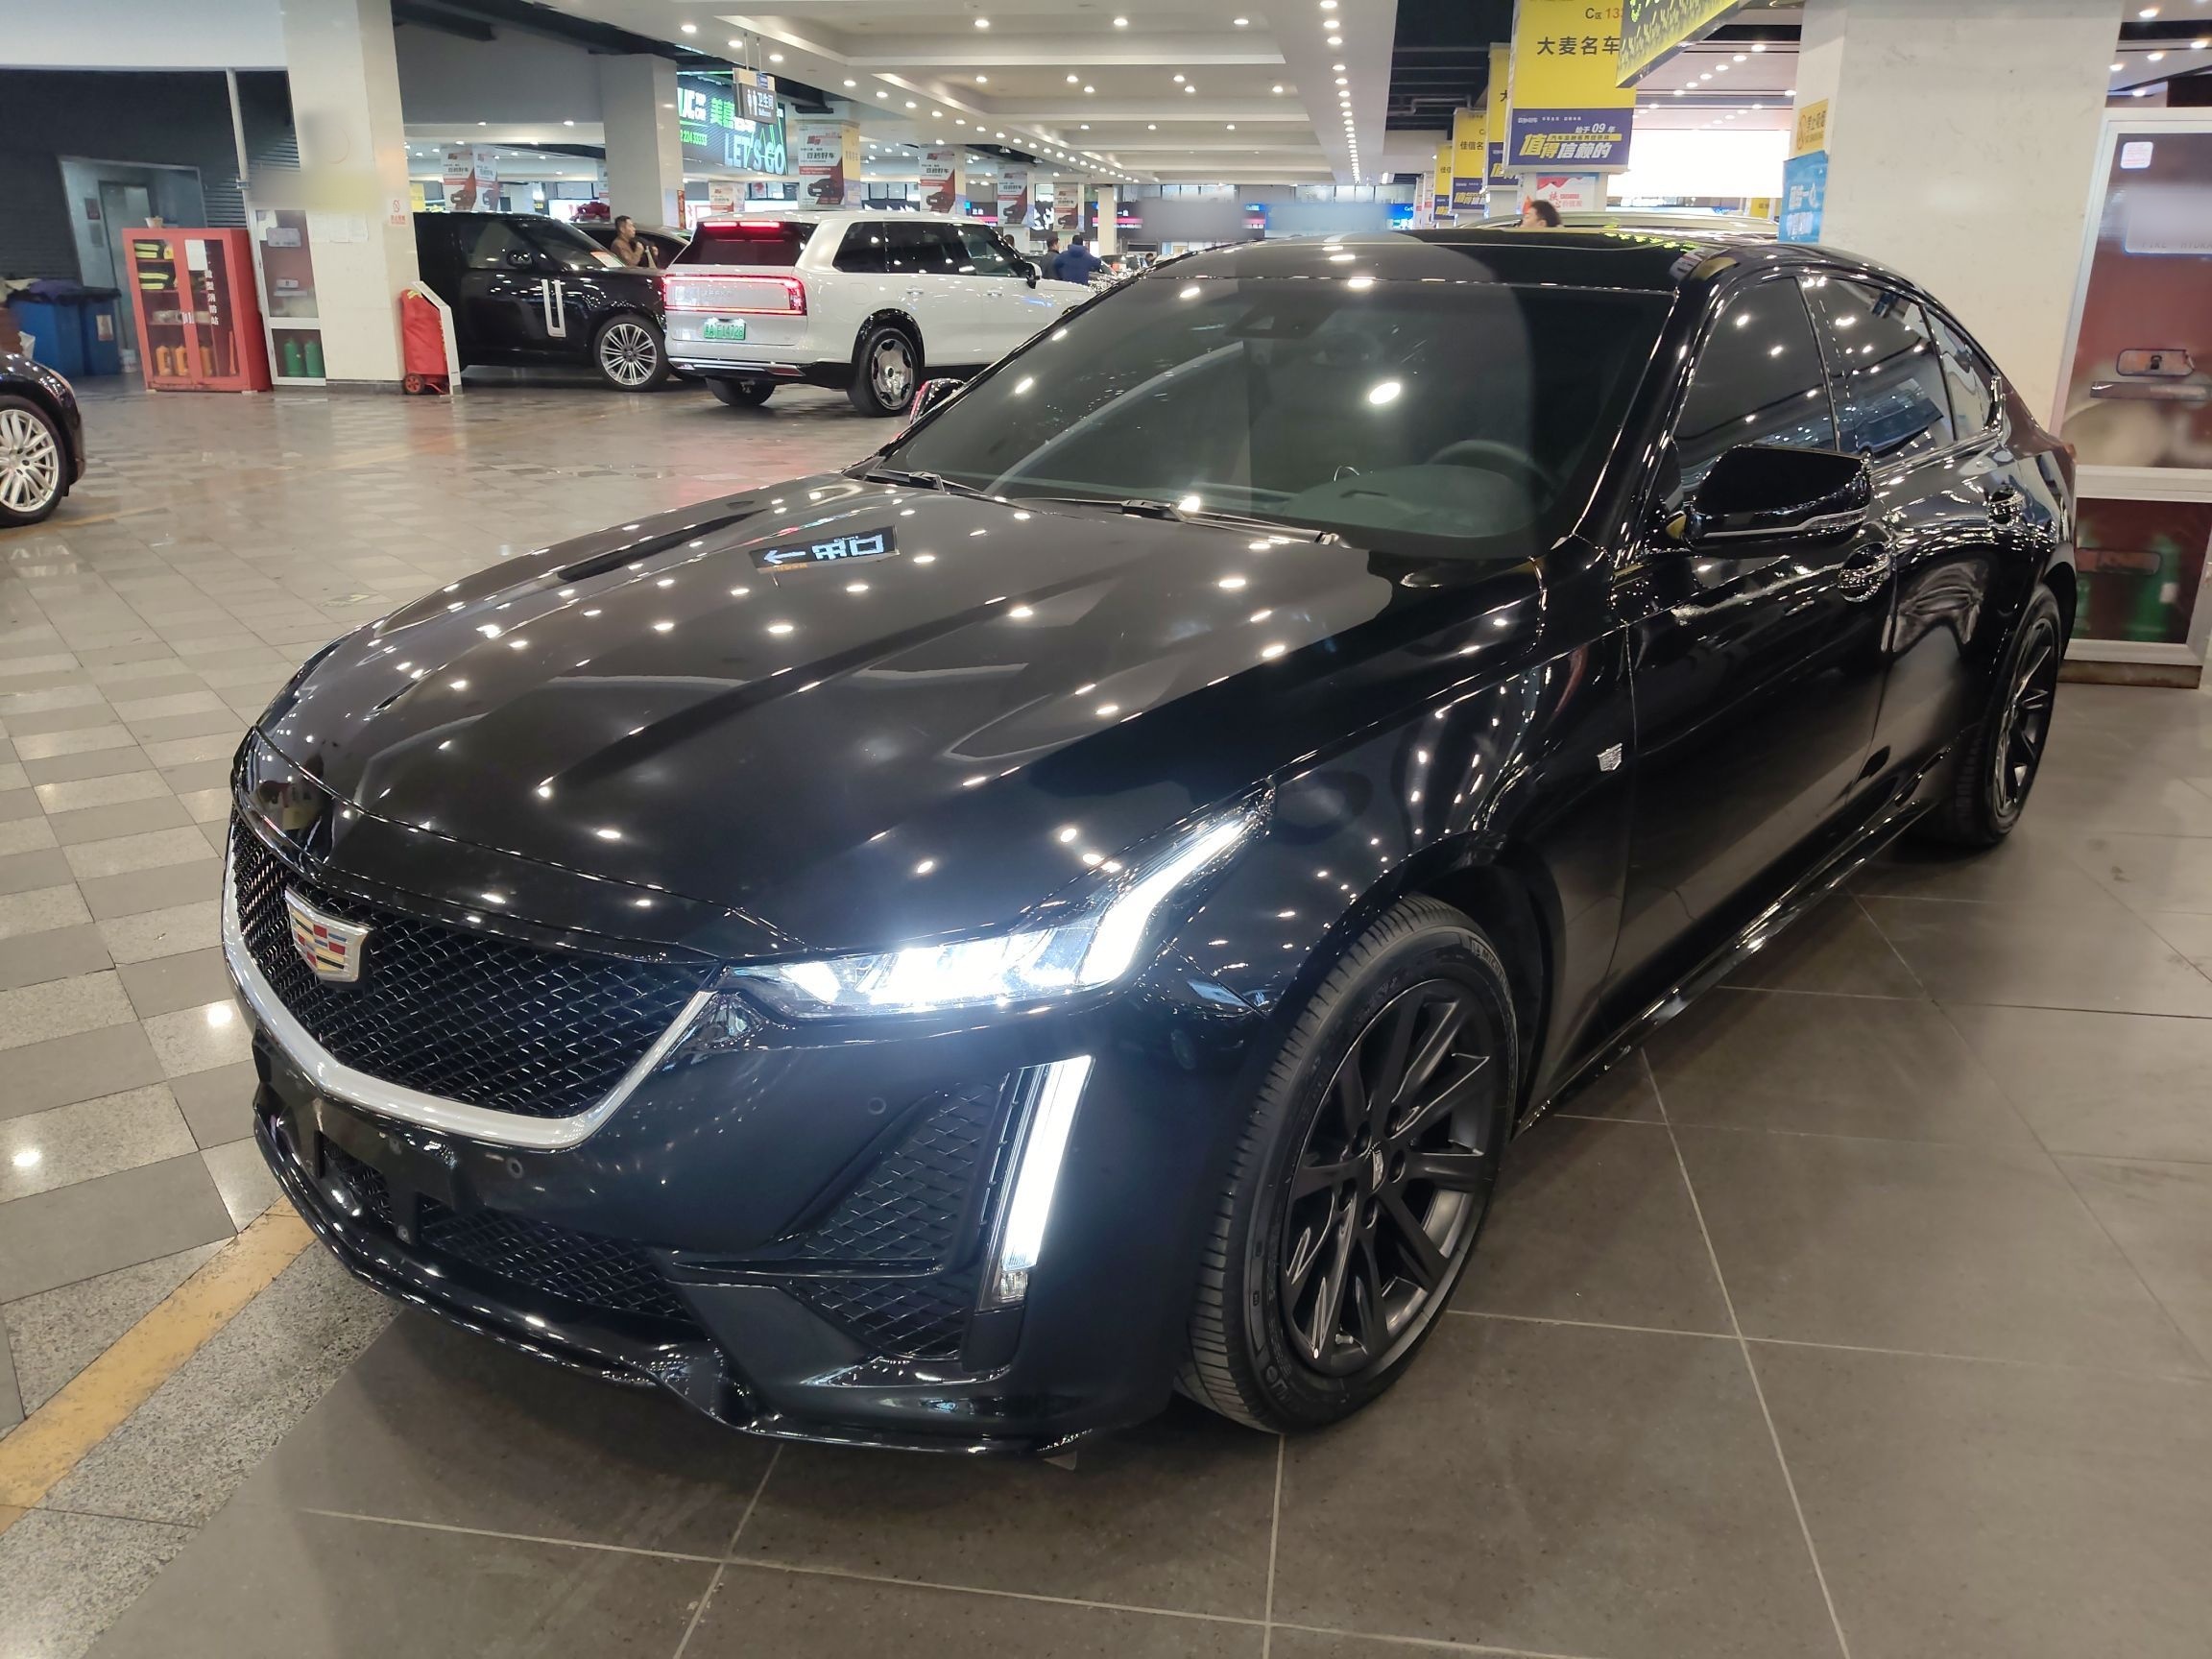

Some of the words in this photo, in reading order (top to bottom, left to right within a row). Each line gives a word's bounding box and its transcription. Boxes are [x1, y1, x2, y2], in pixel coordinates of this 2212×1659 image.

[1605, 8, 1623, 19] 13
[1536, 36, 1621, 56] 大麦名车
[757, 91, 774, 110] 卫生间
[1591, 123, 1606, 133] 09
[724, 132, 762, 171] LET'S
[1519, 133, 1613, 159] 值得信赖的
